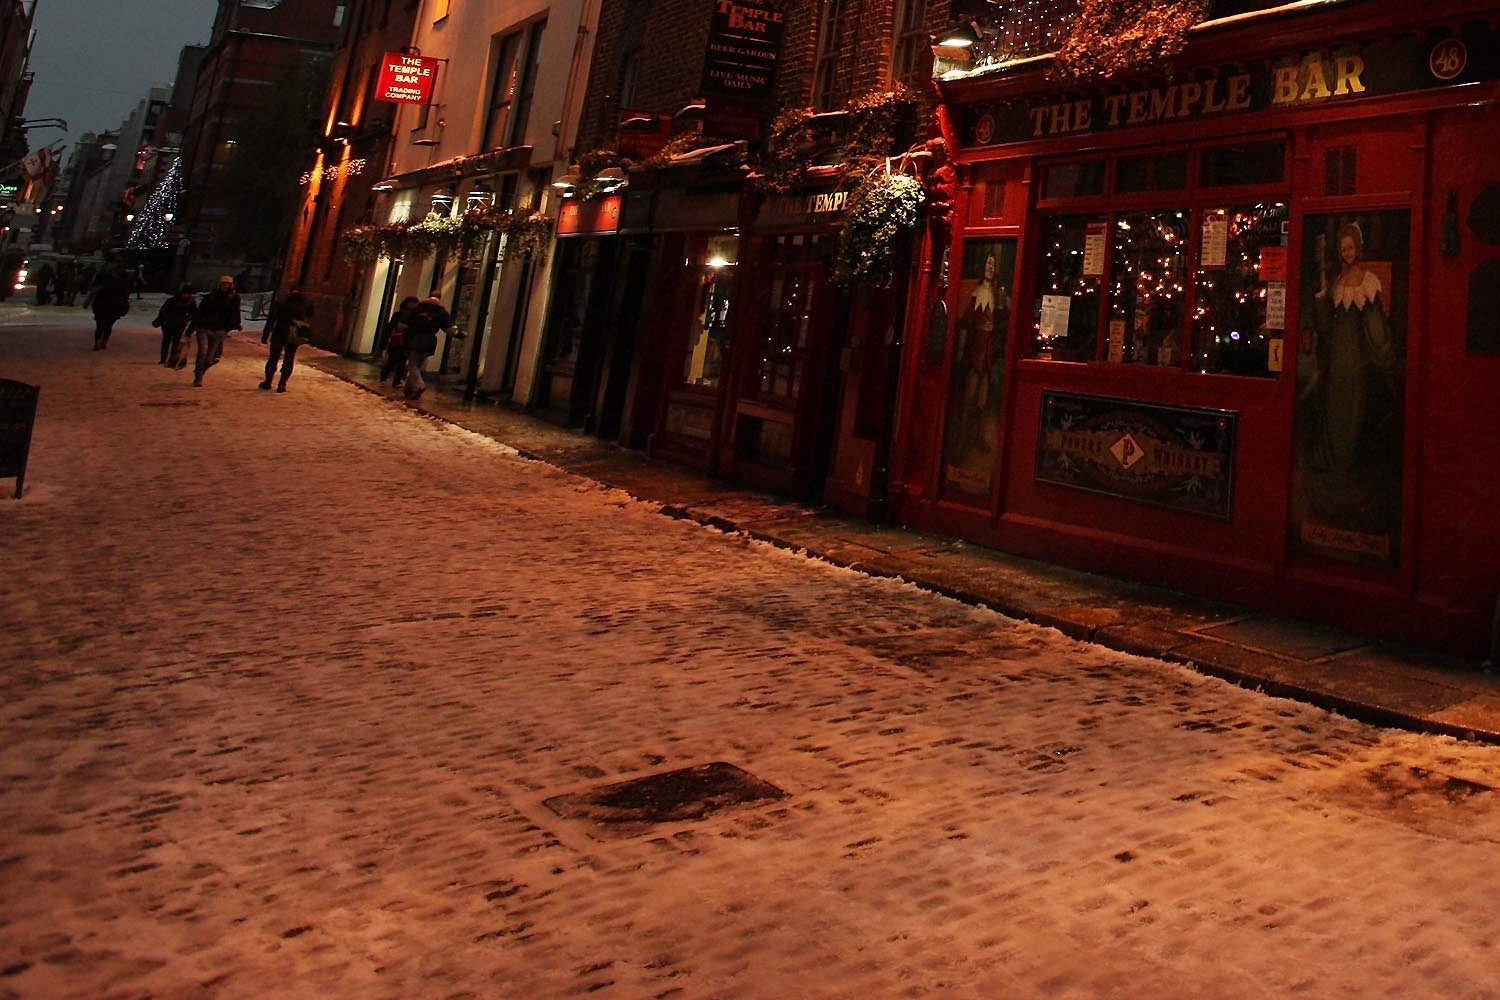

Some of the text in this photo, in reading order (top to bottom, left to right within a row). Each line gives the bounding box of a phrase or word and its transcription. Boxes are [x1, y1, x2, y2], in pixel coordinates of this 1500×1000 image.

[727, 12, 767, 33] BAR
[401, 56, 422, 67] THE
[1435, 46, 1461, 73] 48
[389, 64, 430, 77] TEMPLE
[395, 74, 419, 84] BAR
[385, 92, 421, 101] COMPANY
[389, 86, 421, 95] TRADING
[1030, 55, 1366, 137] THE TEMPLE BAR
[806, 190, 850, 214] TEMPL
[1061, 435, 1209, 472] POWERS P WHISKEY
